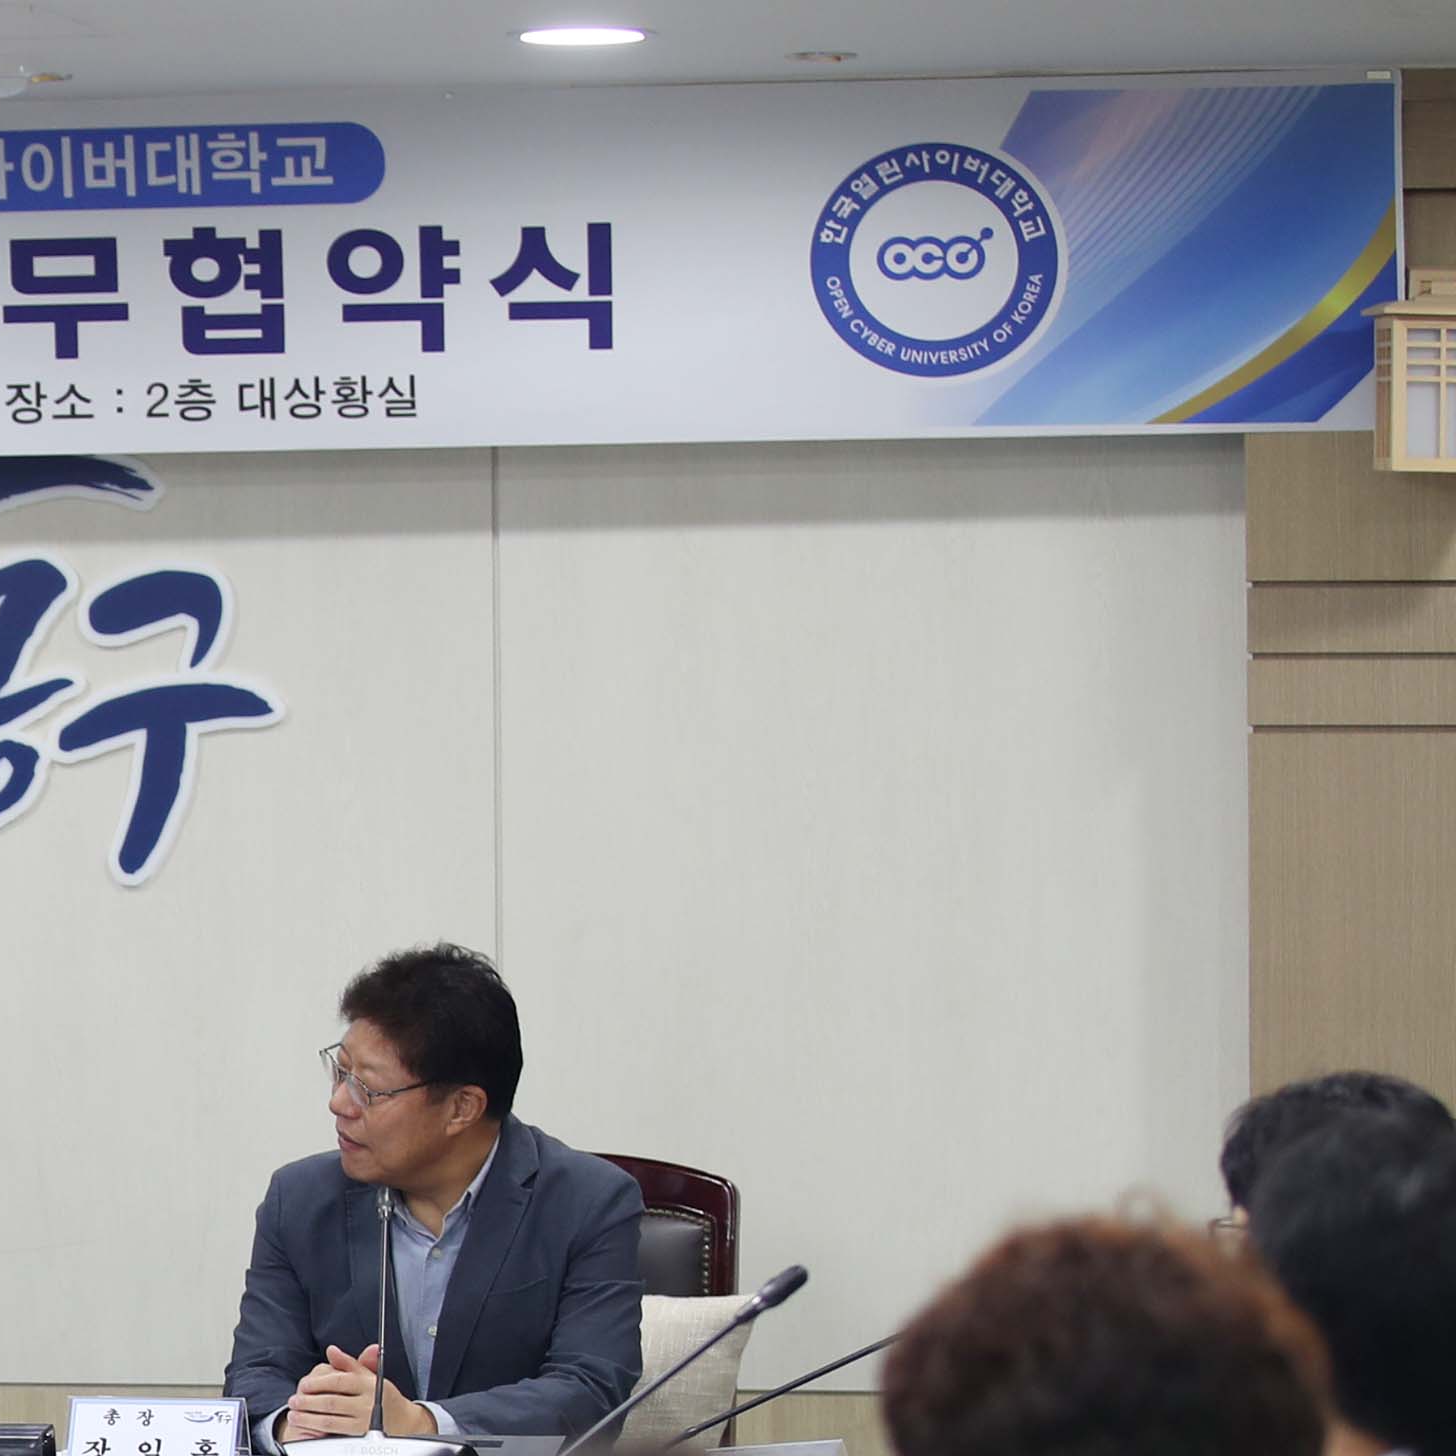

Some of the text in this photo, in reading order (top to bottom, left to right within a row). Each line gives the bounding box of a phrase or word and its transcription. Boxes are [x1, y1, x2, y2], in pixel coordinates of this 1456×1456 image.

[819, 149, 1046, 244] 한국열린사이버대학교
[826, 273, 1044, 365] OPEN CYBER UNIVERSITY OF KOREA
[5, 378, 95, 425] 장소
[146, 382, 218, 423] 2층
[238, 374, 418, 422] 대상황실
